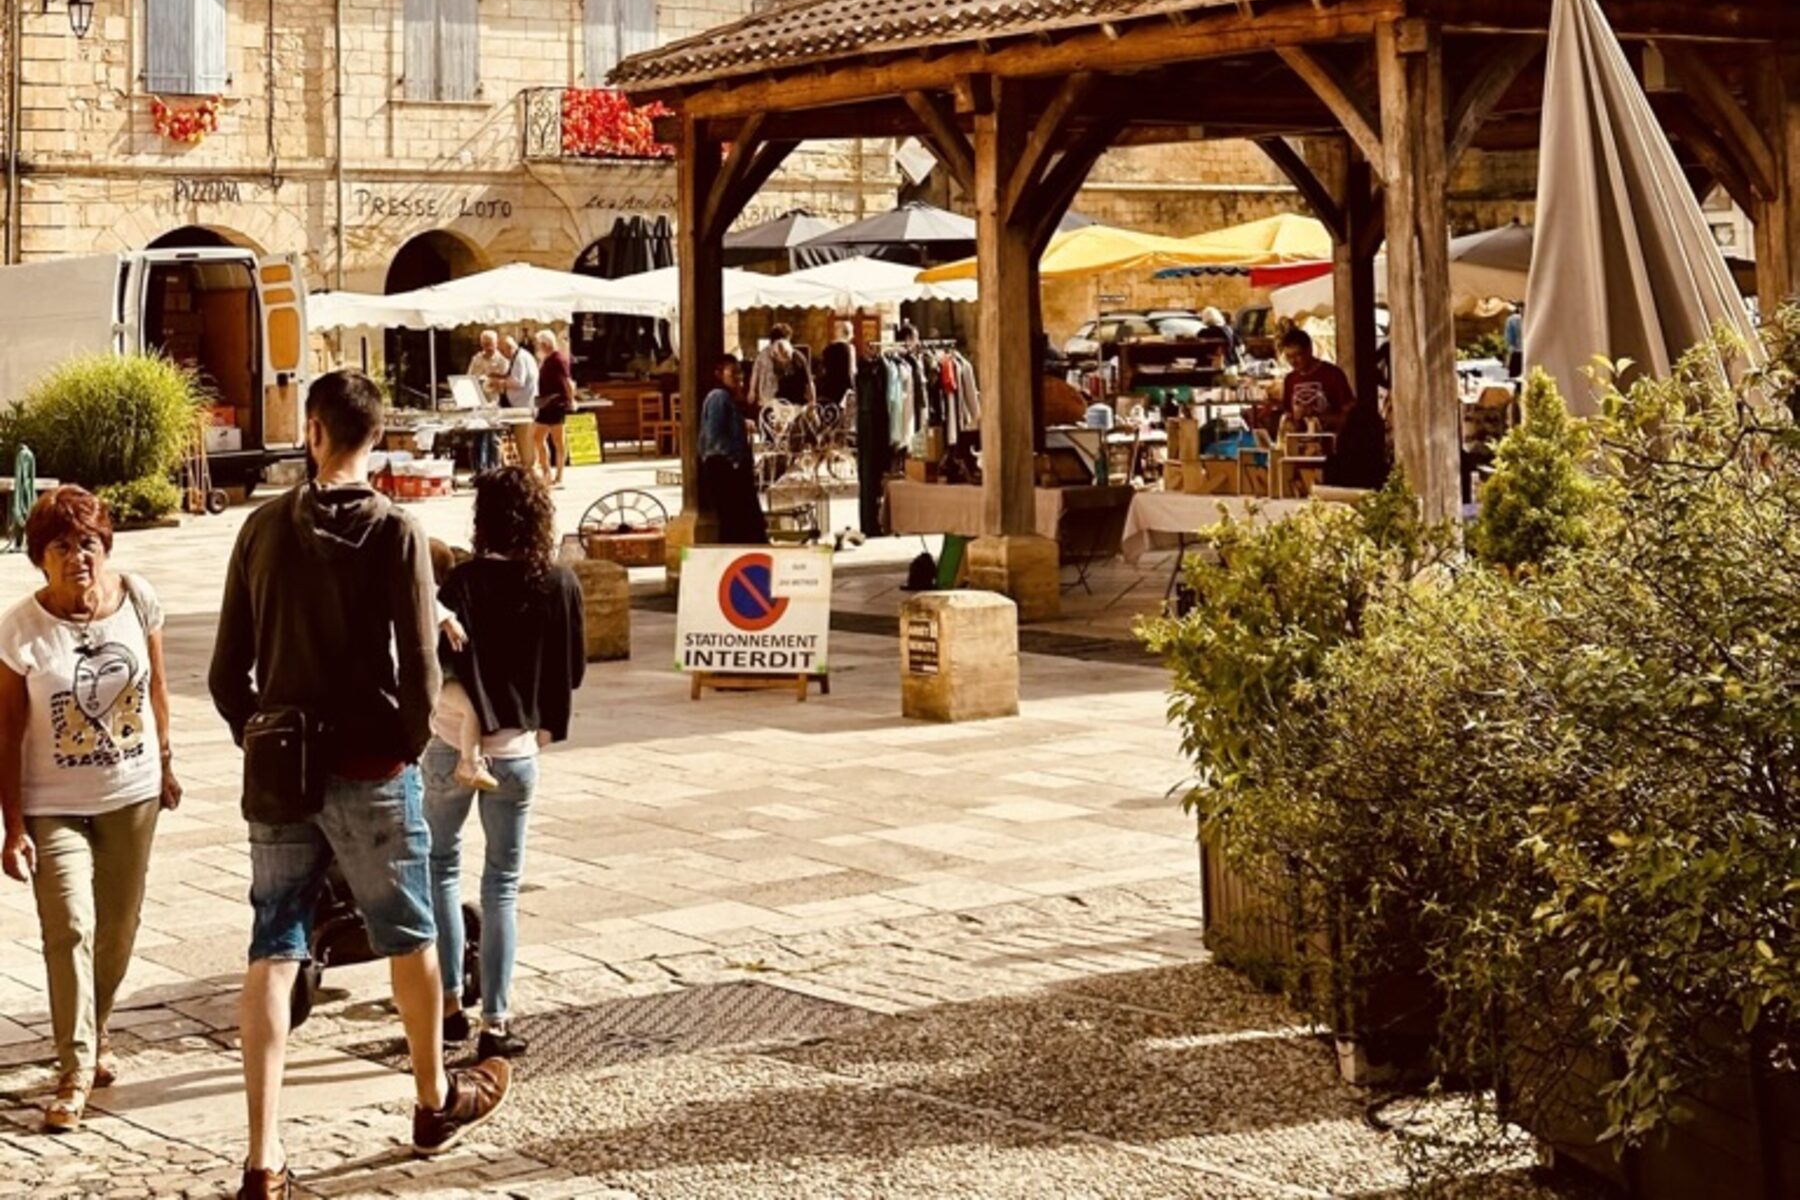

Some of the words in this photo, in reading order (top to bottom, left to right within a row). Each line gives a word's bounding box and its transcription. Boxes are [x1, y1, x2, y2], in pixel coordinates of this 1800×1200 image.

[354, 188, 439, 217] PRESSE
[459, 196, 513, 219] LOTO
[684, 632, 818, 648] STATIONNEMENT
[684, 649, 817, 669] INTERDIT
